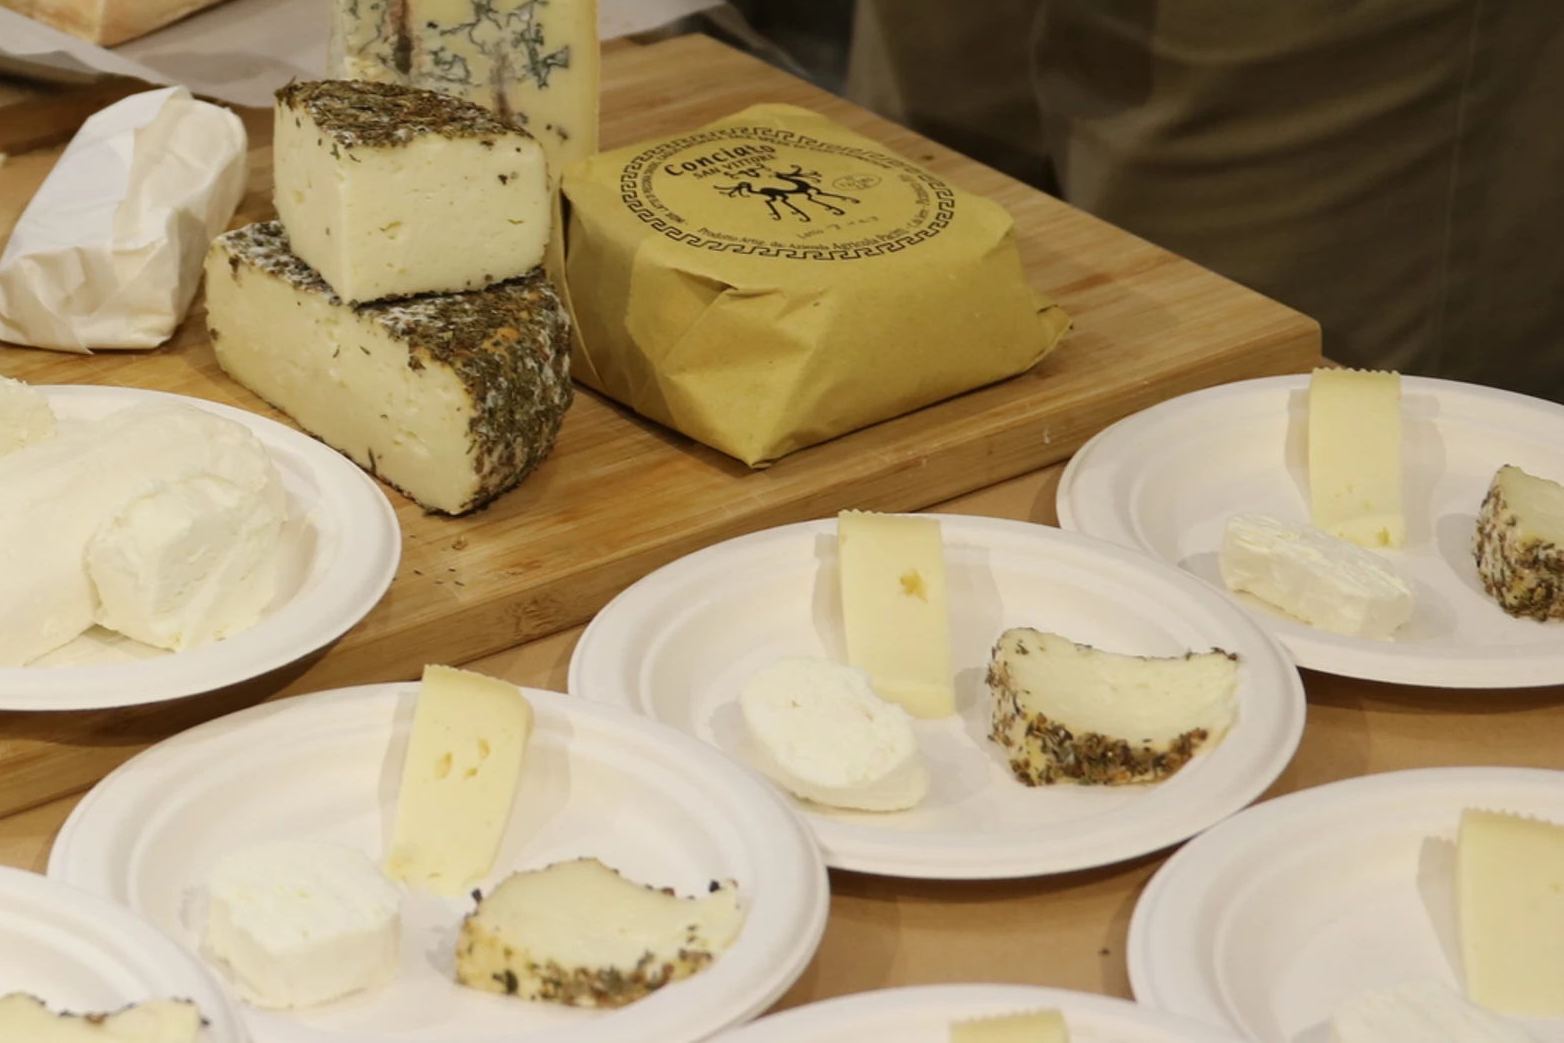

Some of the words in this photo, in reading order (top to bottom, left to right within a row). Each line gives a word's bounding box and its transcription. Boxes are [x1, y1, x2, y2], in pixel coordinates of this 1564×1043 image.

[664, 144, 776, 177] Conciato
[692, 166, 722, 180] SAN
[723, 154, 778, 170] VITTORE
